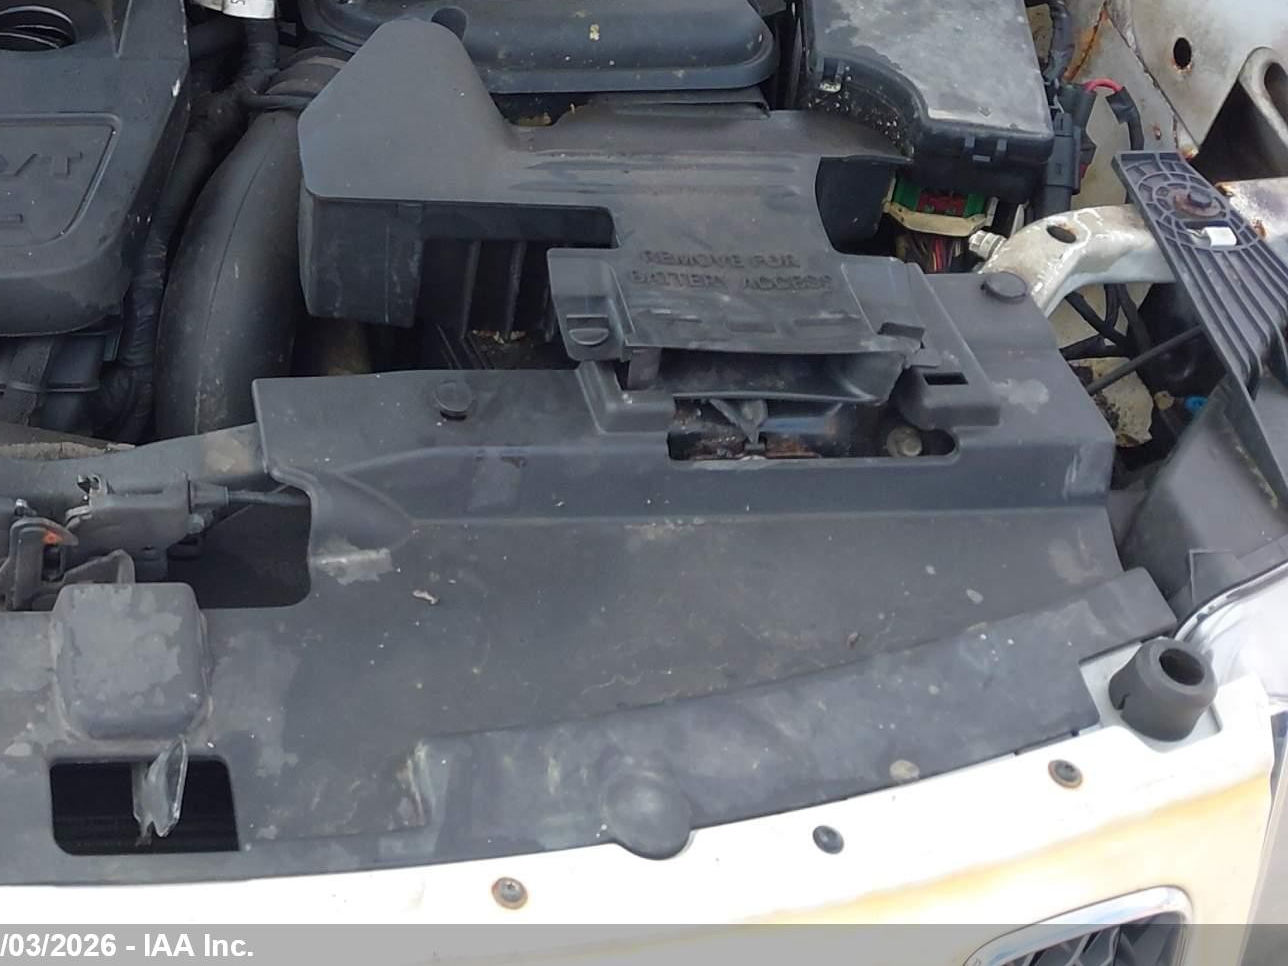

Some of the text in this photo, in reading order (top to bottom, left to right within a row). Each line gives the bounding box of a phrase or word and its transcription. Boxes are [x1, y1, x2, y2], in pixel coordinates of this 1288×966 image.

[641, 249, 800, 269] REMOVE FOR
[629, 269, 833, 291] BATTERY ACCESS
